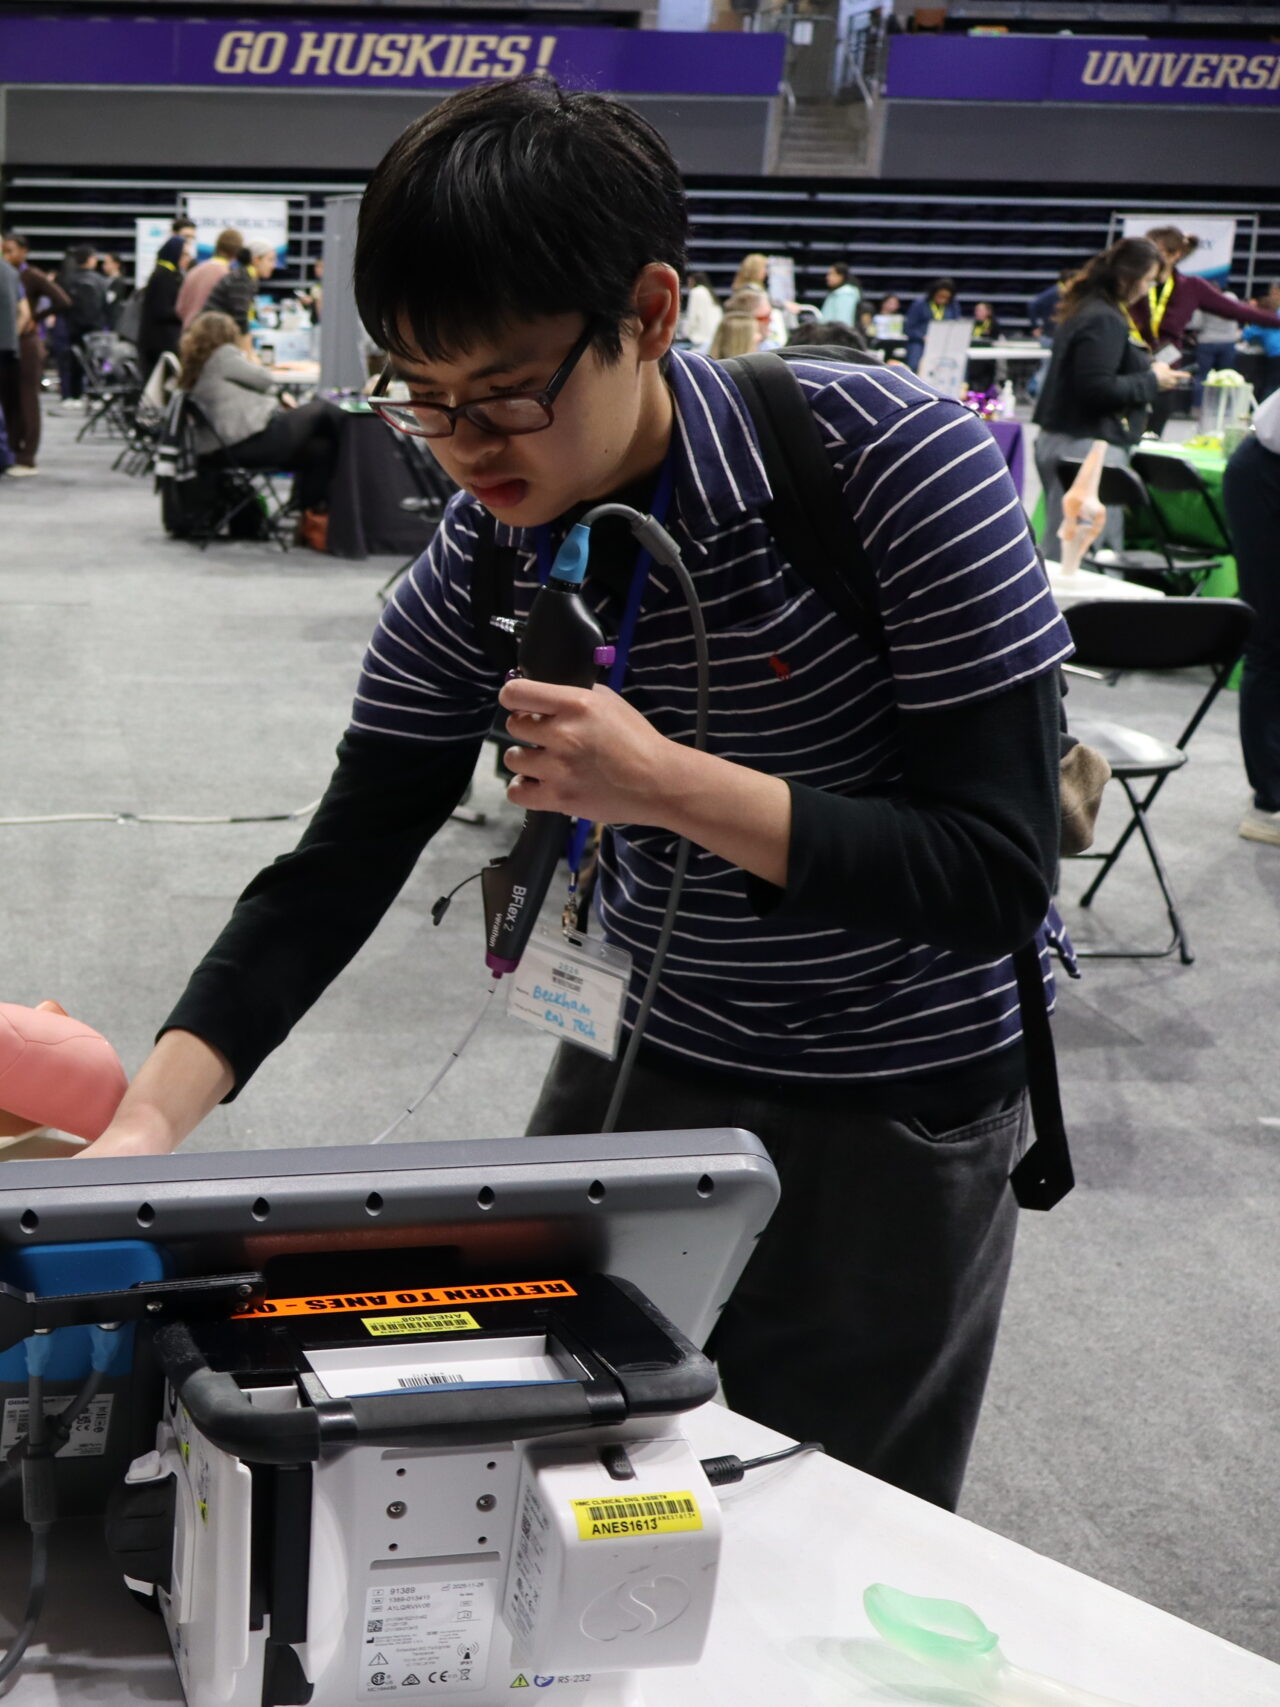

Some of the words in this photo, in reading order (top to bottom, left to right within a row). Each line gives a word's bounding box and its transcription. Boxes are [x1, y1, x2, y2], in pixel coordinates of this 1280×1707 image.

[214, 31, 288, 74] GO
[290, 32, 556, 78] HUSKIES!
[506, 885, 527, 923] BFlex
[489, 913, 503, 947] verathon
[504, 923, 514, 932] 2
[397, 1291, 440, 1304] TO
[444, 1282, 569, 1301] RETURN
[305, 1295, 387, 1310] ANES
[592, 1519, 658, 1535] ANES1613
[557, 1673, 592, 1684] RS-232
